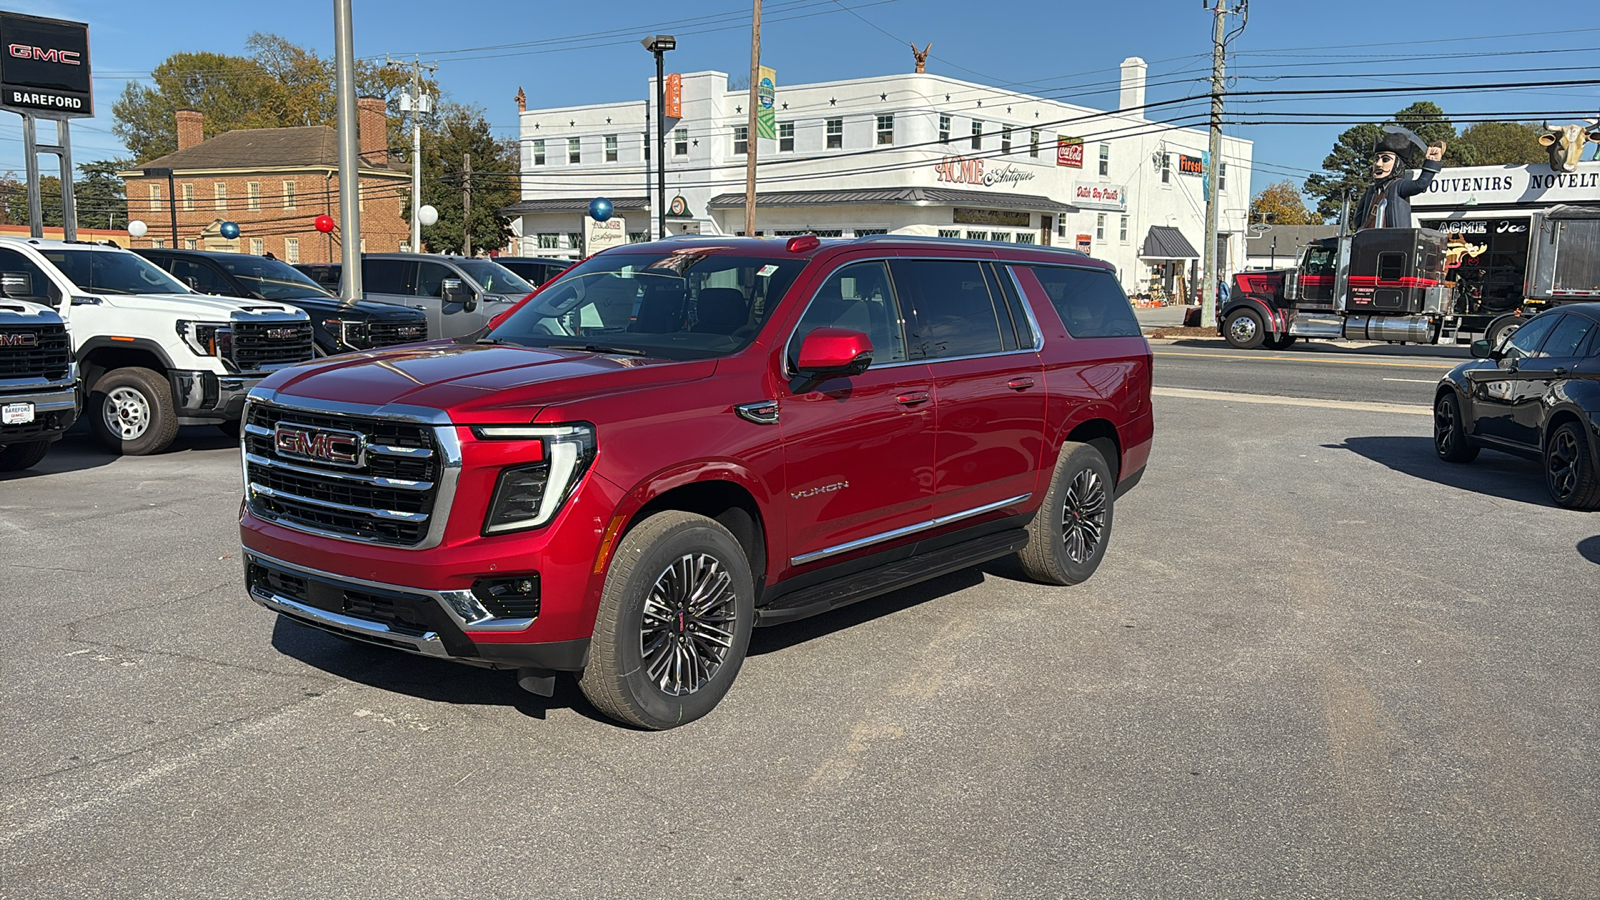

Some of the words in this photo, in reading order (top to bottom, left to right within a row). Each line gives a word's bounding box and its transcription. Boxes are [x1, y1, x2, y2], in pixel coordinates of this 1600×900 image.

[8, 43, 81, 65] GMC
[13, 91, 81, 108] BAREFORD
[672, 76, 680, 115] ACME
[935, 155, 984, 185] ACME
[984, 162, 1035, 188] Antiques
[1531, 172, 1599, 189] NOVELT
[1077, 186, 1091, 198] Dutch
[1092, 187, 1102, 201] Boy
[1102, 188, 1119, 201] Paints
[1439, 221, 1487, 234] ACME
[0, 333, 35, 346] MC
[4, 405, 30, 413] BAREFORD
[275, 428, 355, 462] GMC
[790, 481, 850, 499] YUKON
